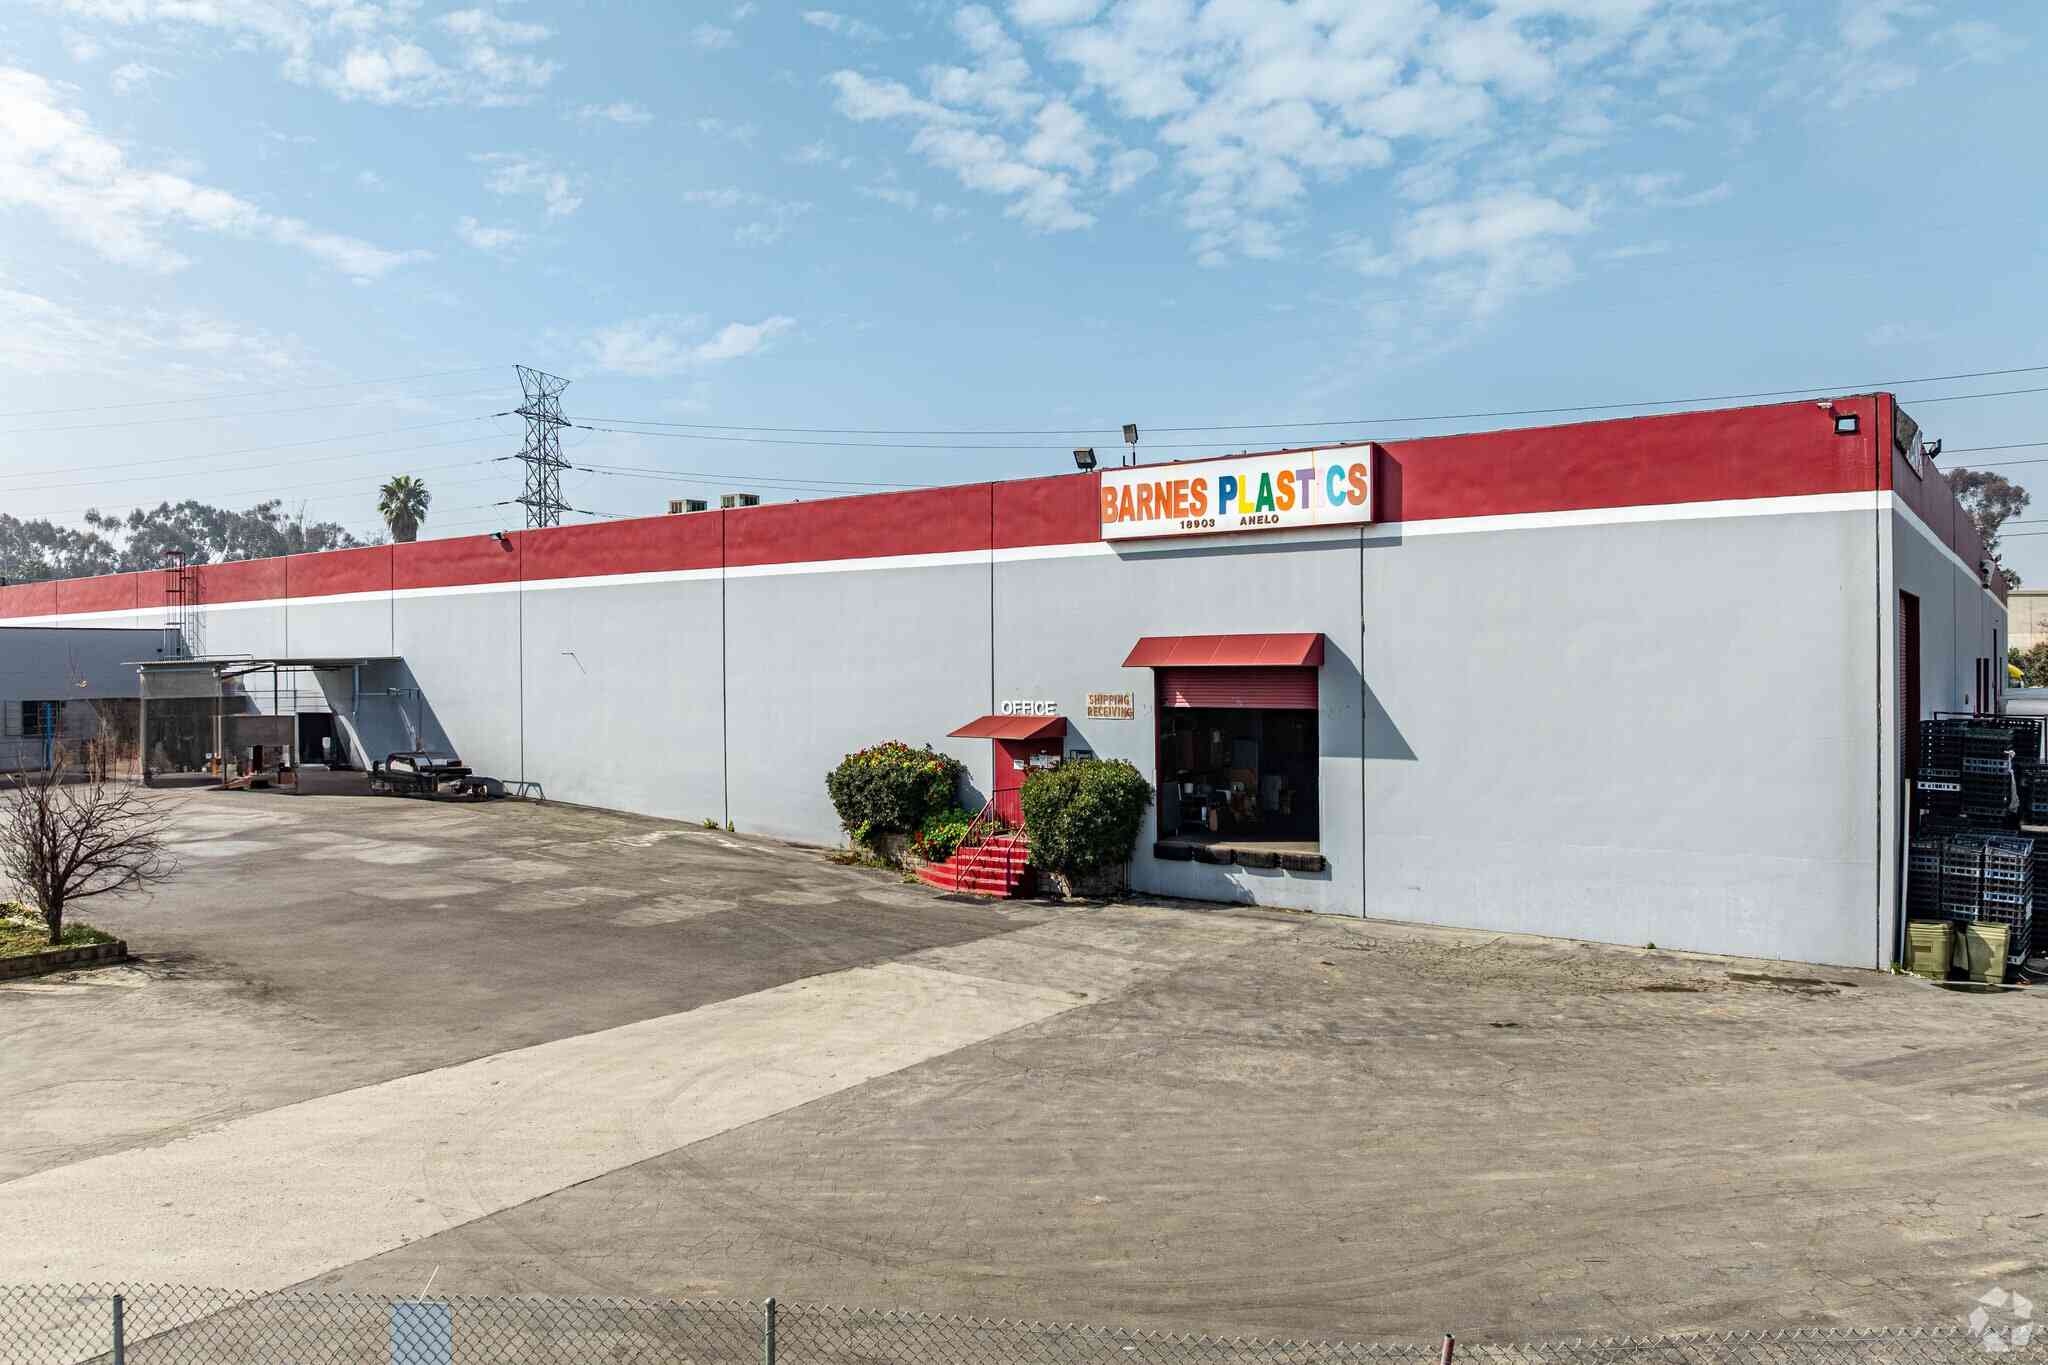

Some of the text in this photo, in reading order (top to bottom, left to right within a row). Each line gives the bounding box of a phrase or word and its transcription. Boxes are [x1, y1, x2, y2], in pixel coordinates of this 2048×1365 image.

[1102, 474, 1208, 523] BARNES
[1179, 518, 1216, 529] 18903
[1088, 694, 1130, 705] SHIPPING
[1001, 700, 1057, 715] OFFICE
[1087, 706, 1133, 717] RECEIVING
